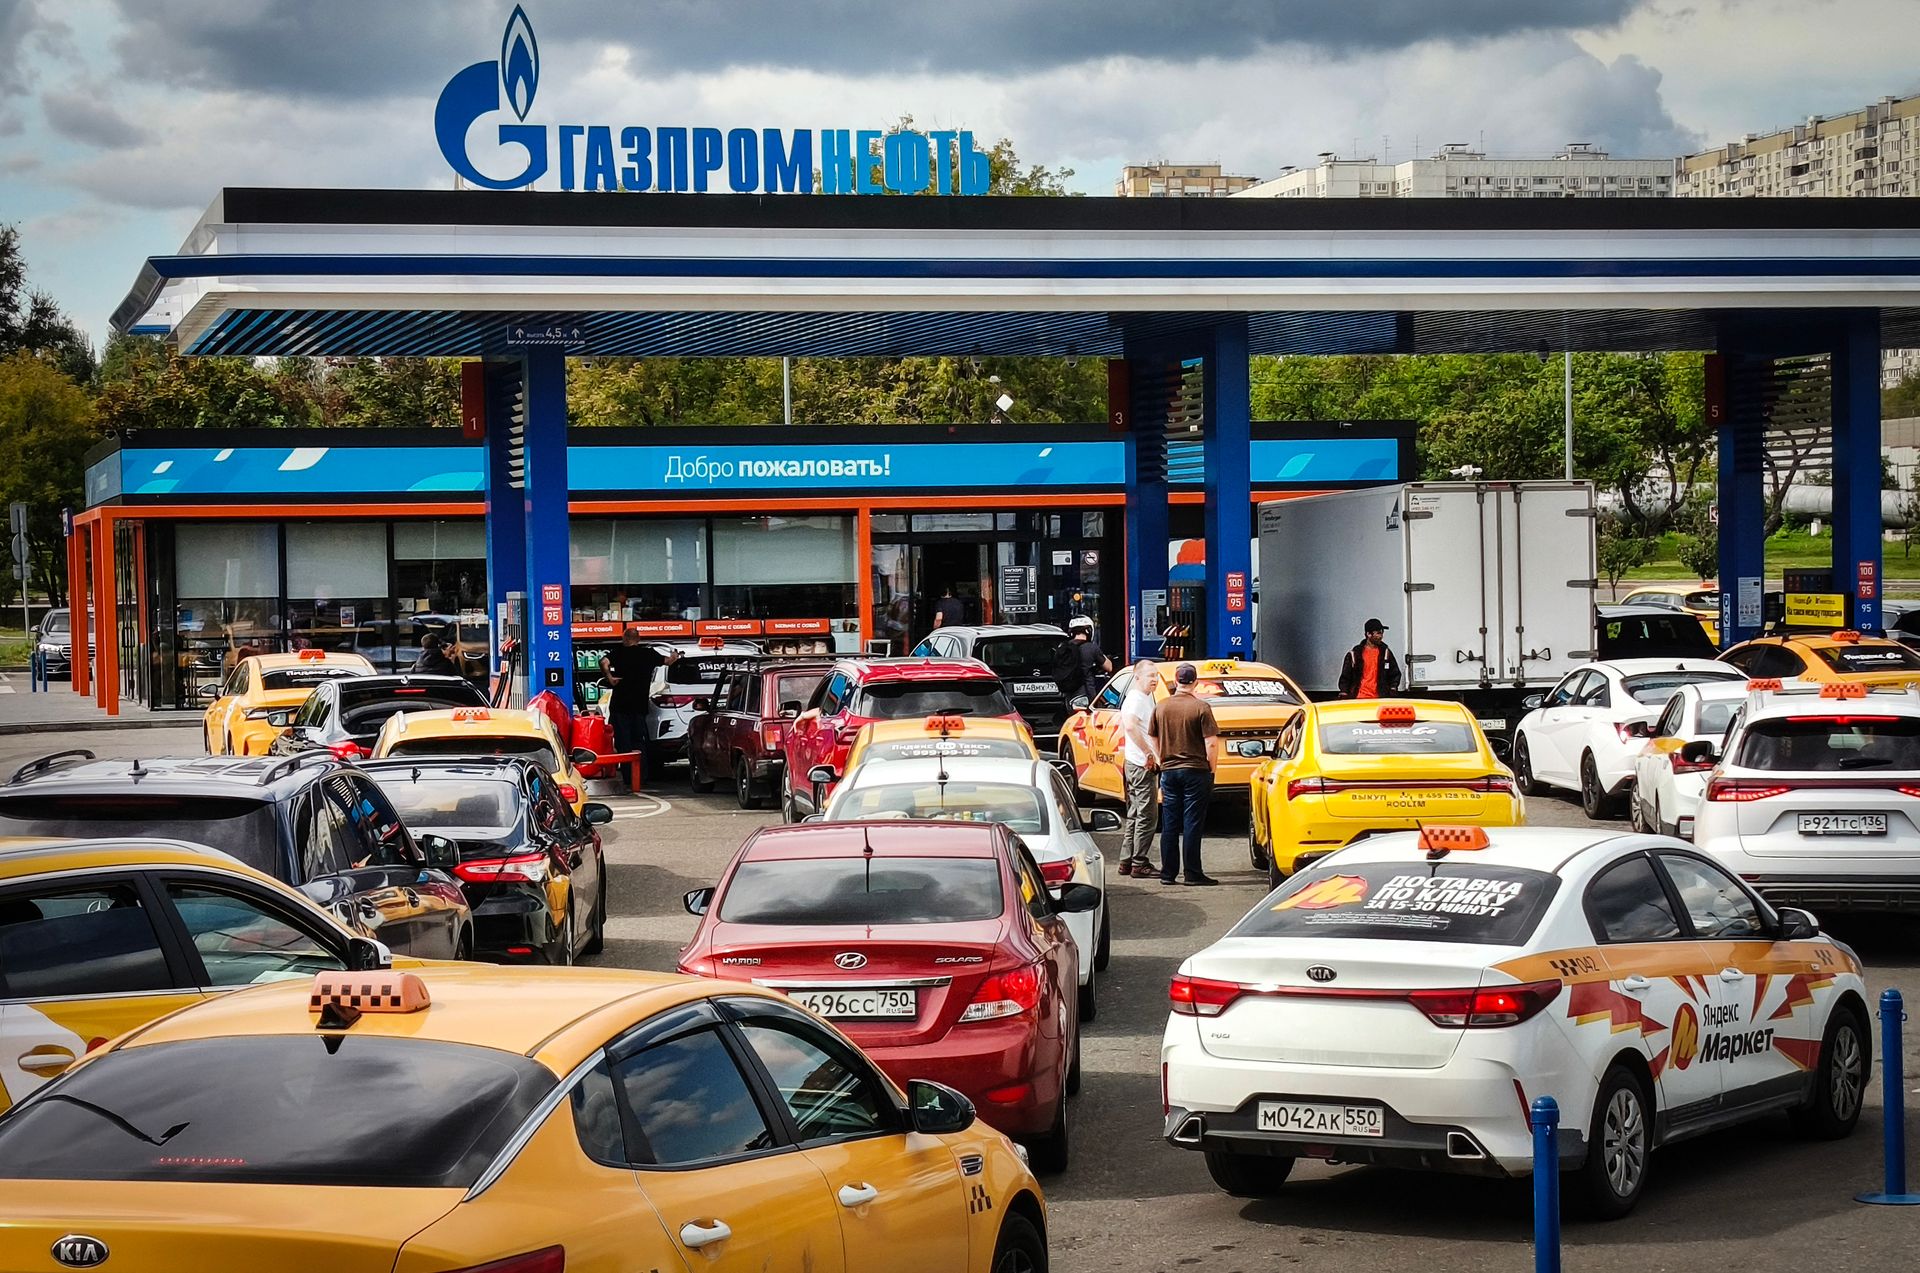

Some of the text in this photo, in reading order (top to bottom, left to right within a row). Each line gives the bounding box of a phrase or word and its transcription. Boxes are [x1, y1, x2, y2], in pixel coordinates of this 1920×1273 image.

[558, 125, 991, 195] ГАЗПРОМНЕФТЬ
[545, 328, 562, 339] 4,5
[1711, 405, 1719, 418] 5
[470, 417, 476, 430] 1
[1115, 412, 1123, 424] 3
[664, 454, 891, 484] Добро пожаловать!
[1860, 566, 1873, 576] 100
[1228, 578, 1242, 588] 100
[544, 590, 560, 600] 100
[1861, 586, 1872, 594] 95
[1230, 598, 1242, 606] 95
[1861, 604, 1872, 612] 95
[546, 612, 559, 621] 95
[547, 630, 560, 640] 95
[1230, 636, 1242, 646] 92
[548, 652, 560, 661] 92
[550, 672, 558, 682] D
[1352, 728, 1410, 736] Яндекс
[1804, 816, 1882, 830] Р921ТС 136
[1383, 876, 1523, 896] ДОСТАВКА
[1373, 886, 1516, 908] ПО КЛИКУ
[1364, 899, 1505, 918] ЗА 15-30 МИНУТ
[1575, 955, 1600, 974] 042
[1309, 968, 1333, 980] KIA
[802, 992, 909, 1014] 696СС 750
[1702, 1002, 1739, 1028] Яндекс
[1700, 1028, 1774, 1064] Маркет
[1263, 1106, 1376, 1130] М042АК 550
[60, 1243, 98, 1261] KIA
